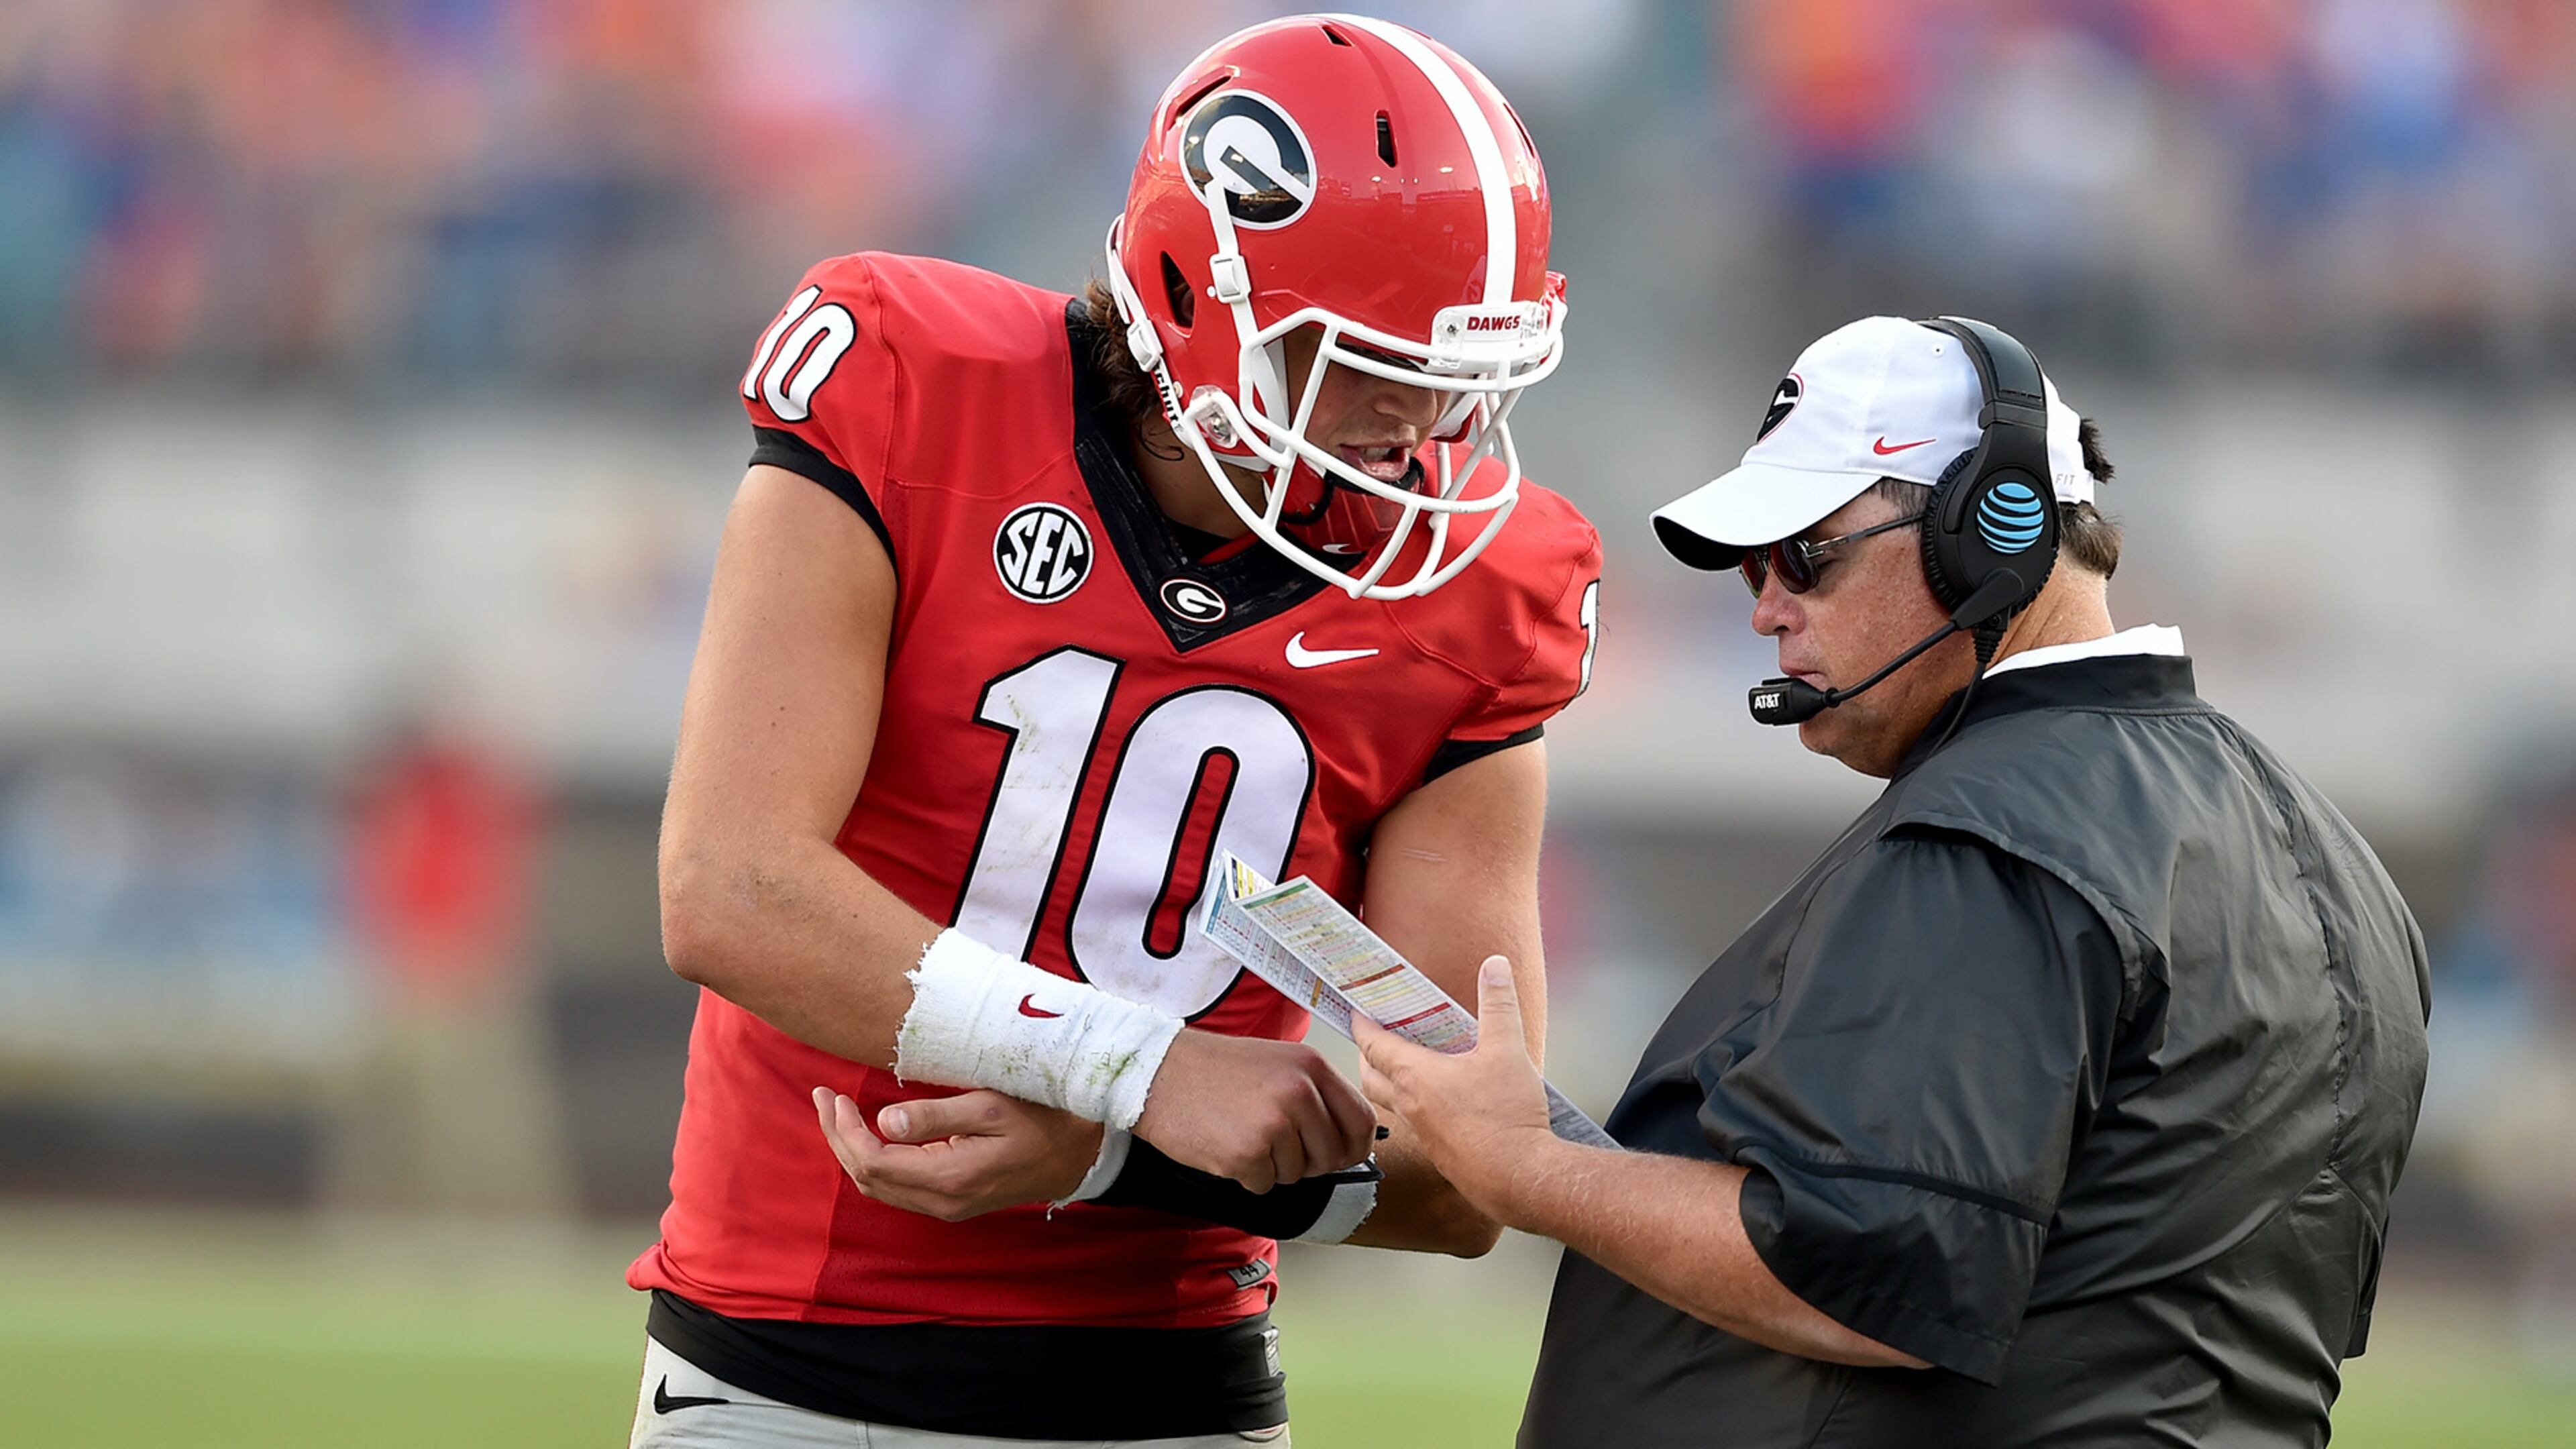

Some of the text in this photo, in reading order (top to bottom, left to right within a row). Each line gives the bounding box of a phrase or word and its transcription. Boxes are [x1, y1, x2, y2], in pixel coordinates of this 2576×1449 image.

[1466, 315, 1521, 331] DAWGS
[743, 283, 857, 424] 10
[2055, 473, 2076, 486] FIT
[1002, 511, 1084, 596] SEC
[1162, 580, 1225, 621] G
[1754, 692, 1781, 710] AT&T
[948, 643, 1316, 1024] 10
